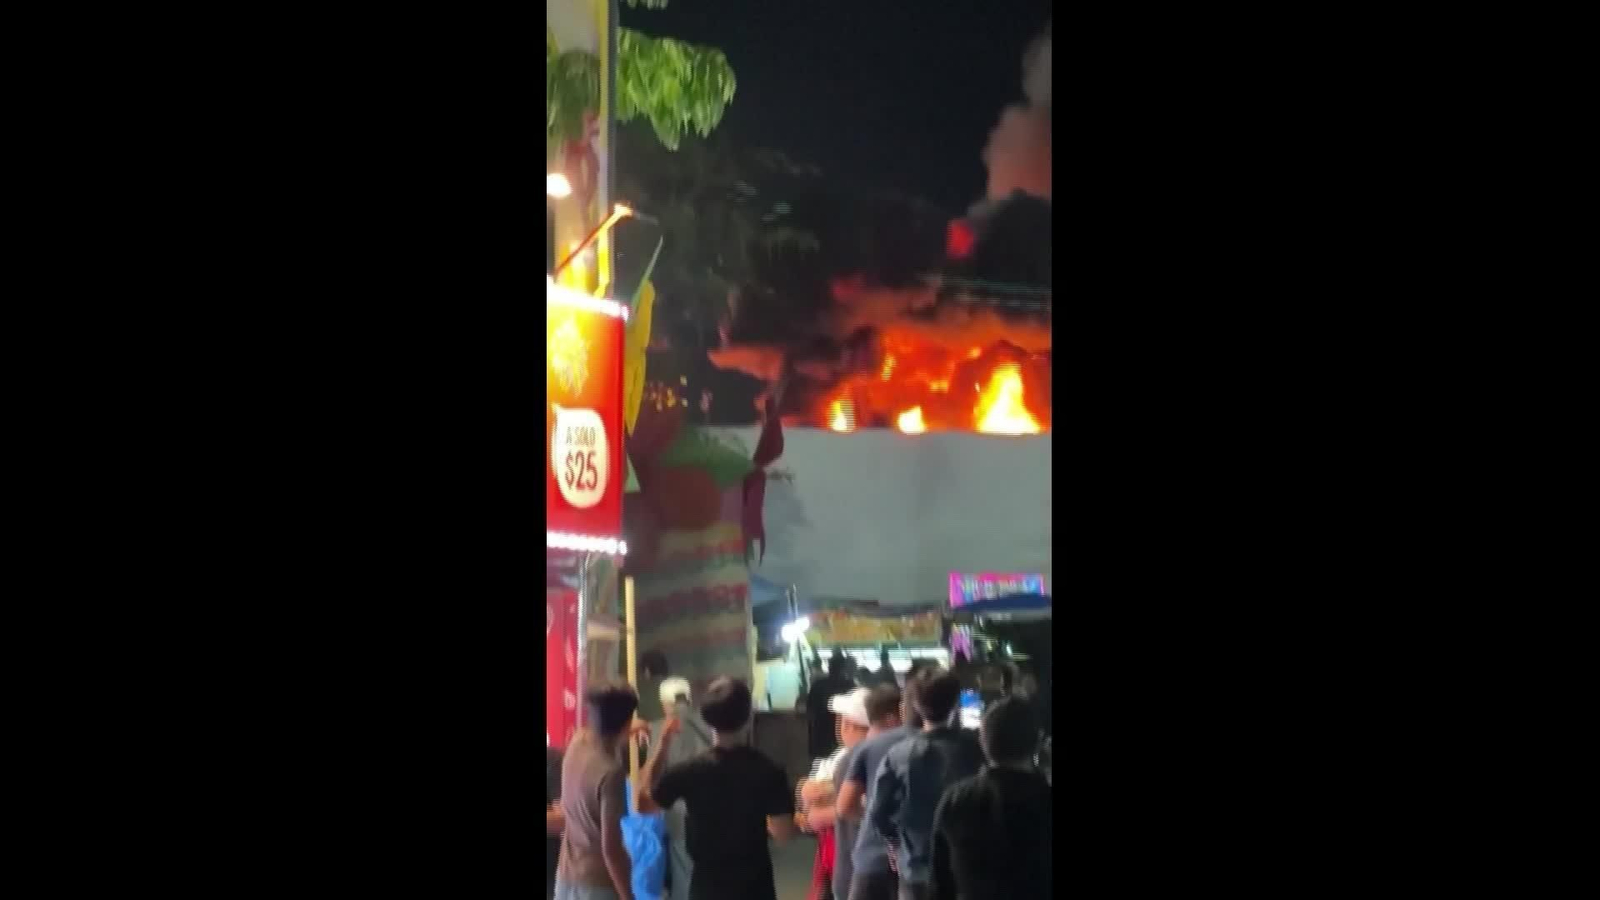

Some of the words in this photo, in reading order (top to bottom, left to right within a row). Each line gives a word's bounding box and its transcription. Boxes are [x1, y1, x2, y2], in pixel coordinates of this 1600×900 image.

[565, 426, 573, 445] A
[574, 426, 596, 446] SOLO
[564, 450, 598, 490] $25
